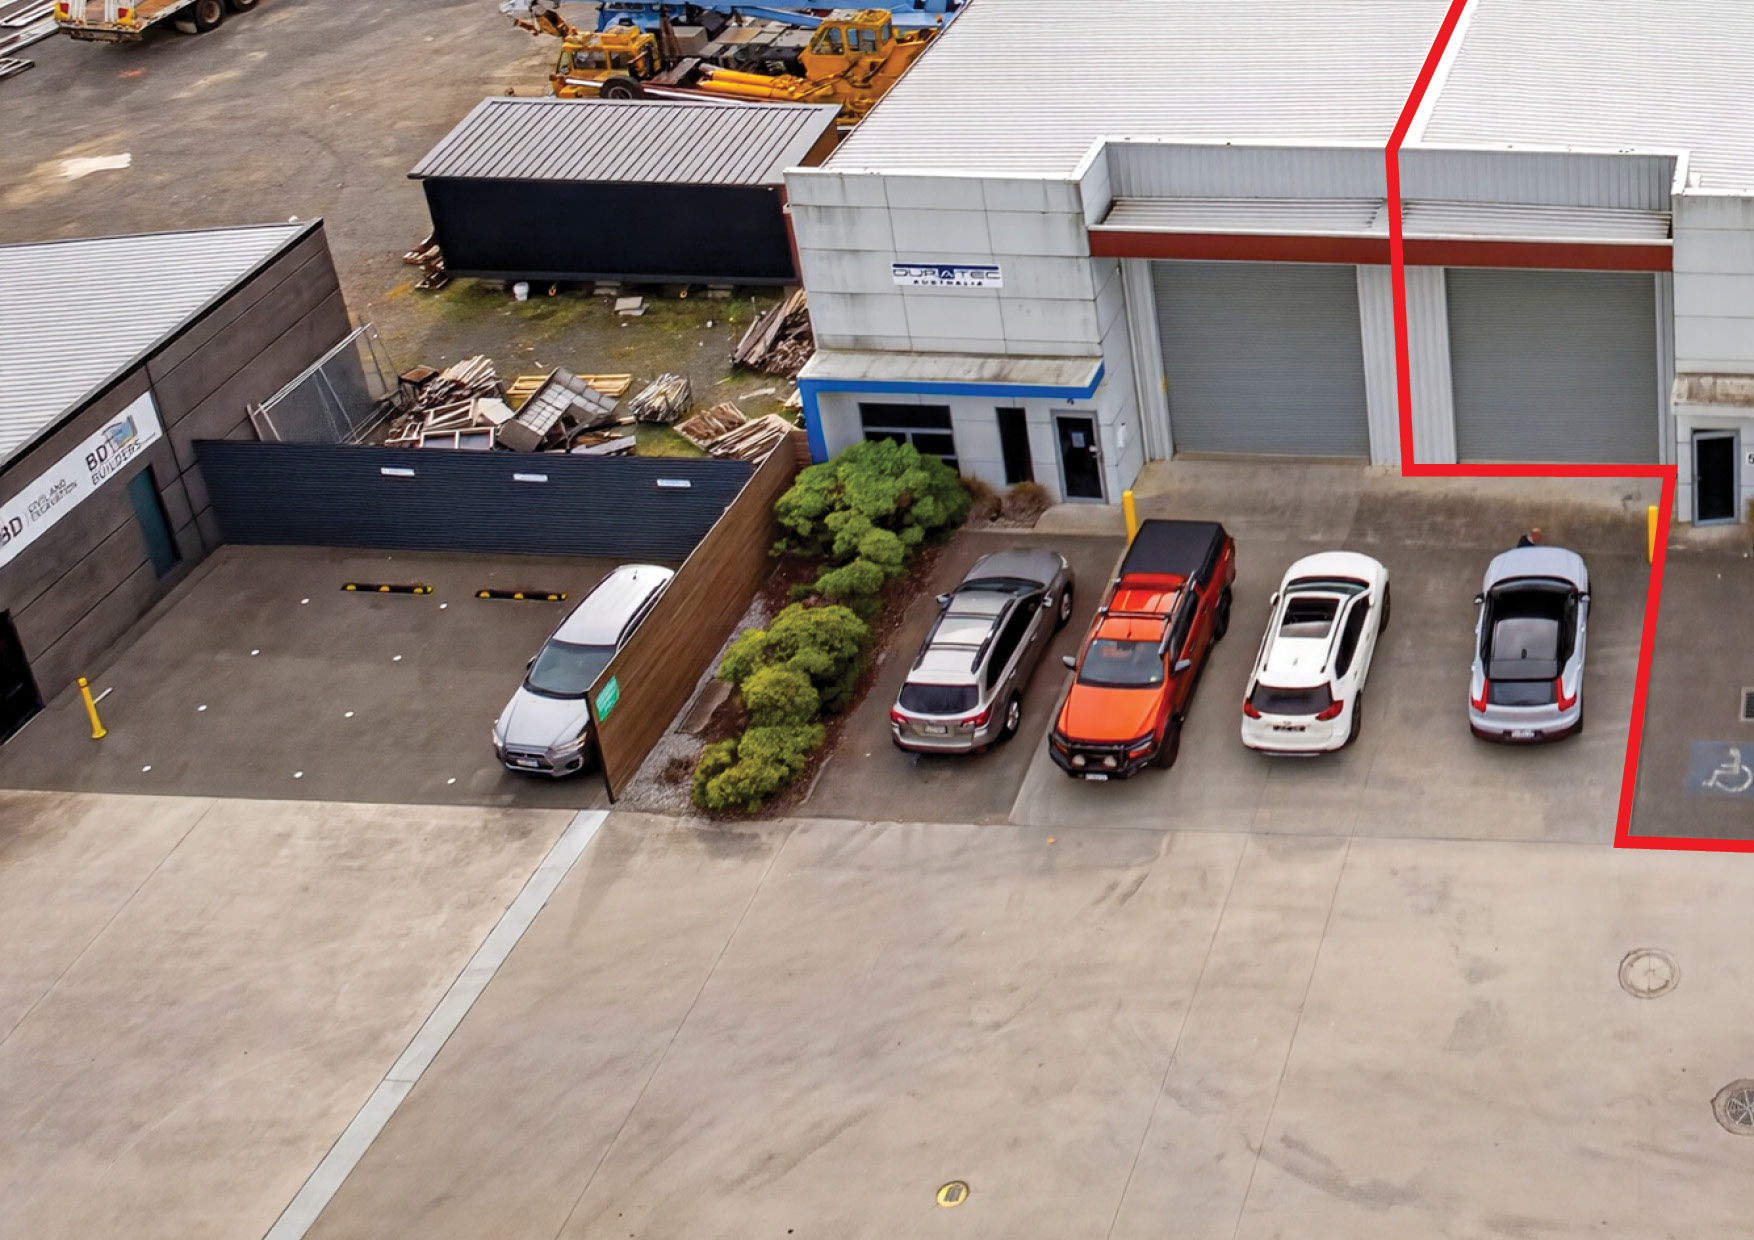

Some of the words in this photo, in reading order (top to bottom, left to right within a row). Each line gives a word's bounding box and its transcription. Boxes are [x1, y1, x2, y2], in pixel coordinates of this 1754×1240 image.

[892, 268, 1001, 279] DURATEC
[85, 444, 109, 472] BD
[91, 438, 142, 486] BUILDERS
